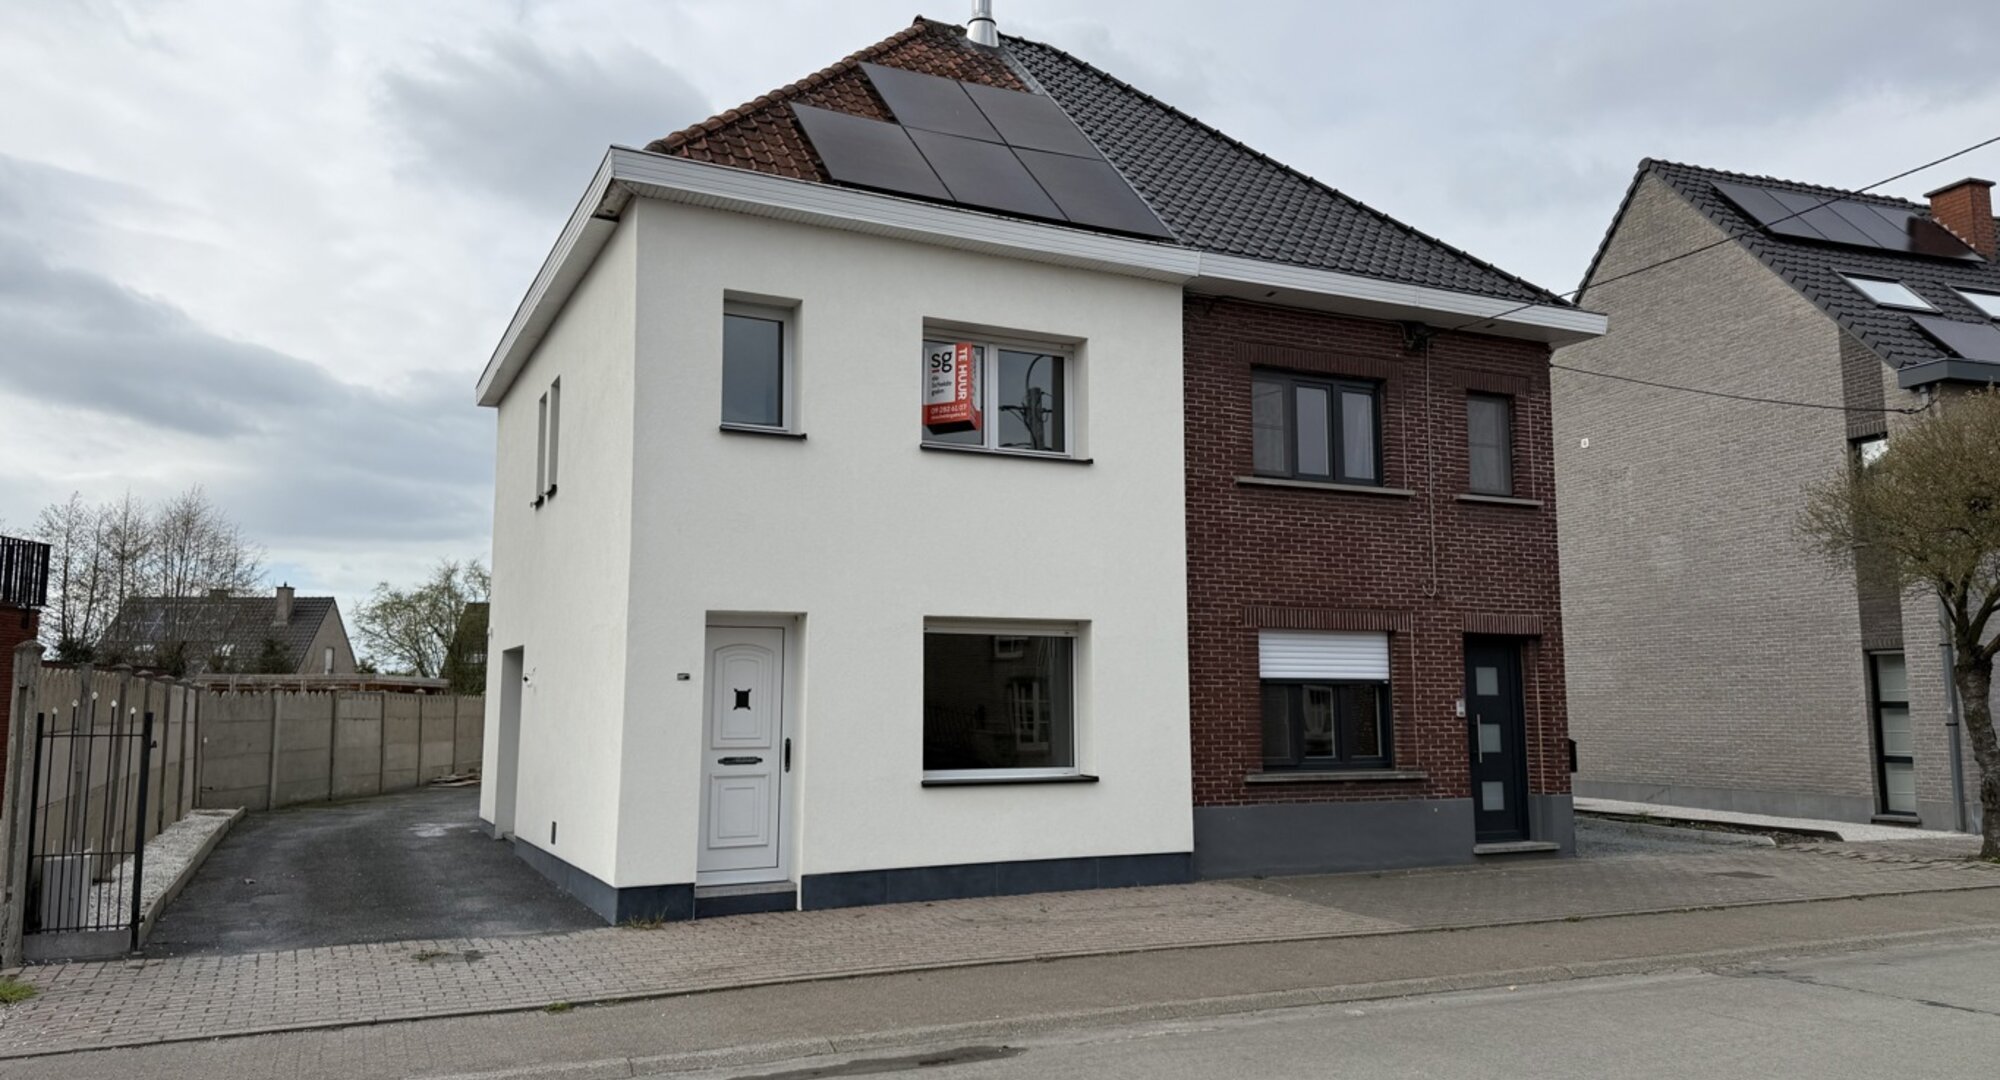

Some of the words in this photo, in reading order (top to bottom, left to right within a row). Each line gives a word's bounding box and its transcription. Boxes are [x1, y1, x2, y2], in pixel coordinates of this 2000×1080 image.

[931, 351, 953, 373] sg
[957, 347, 968, 362] TE
[957, 364, 968, 400] HUUR
